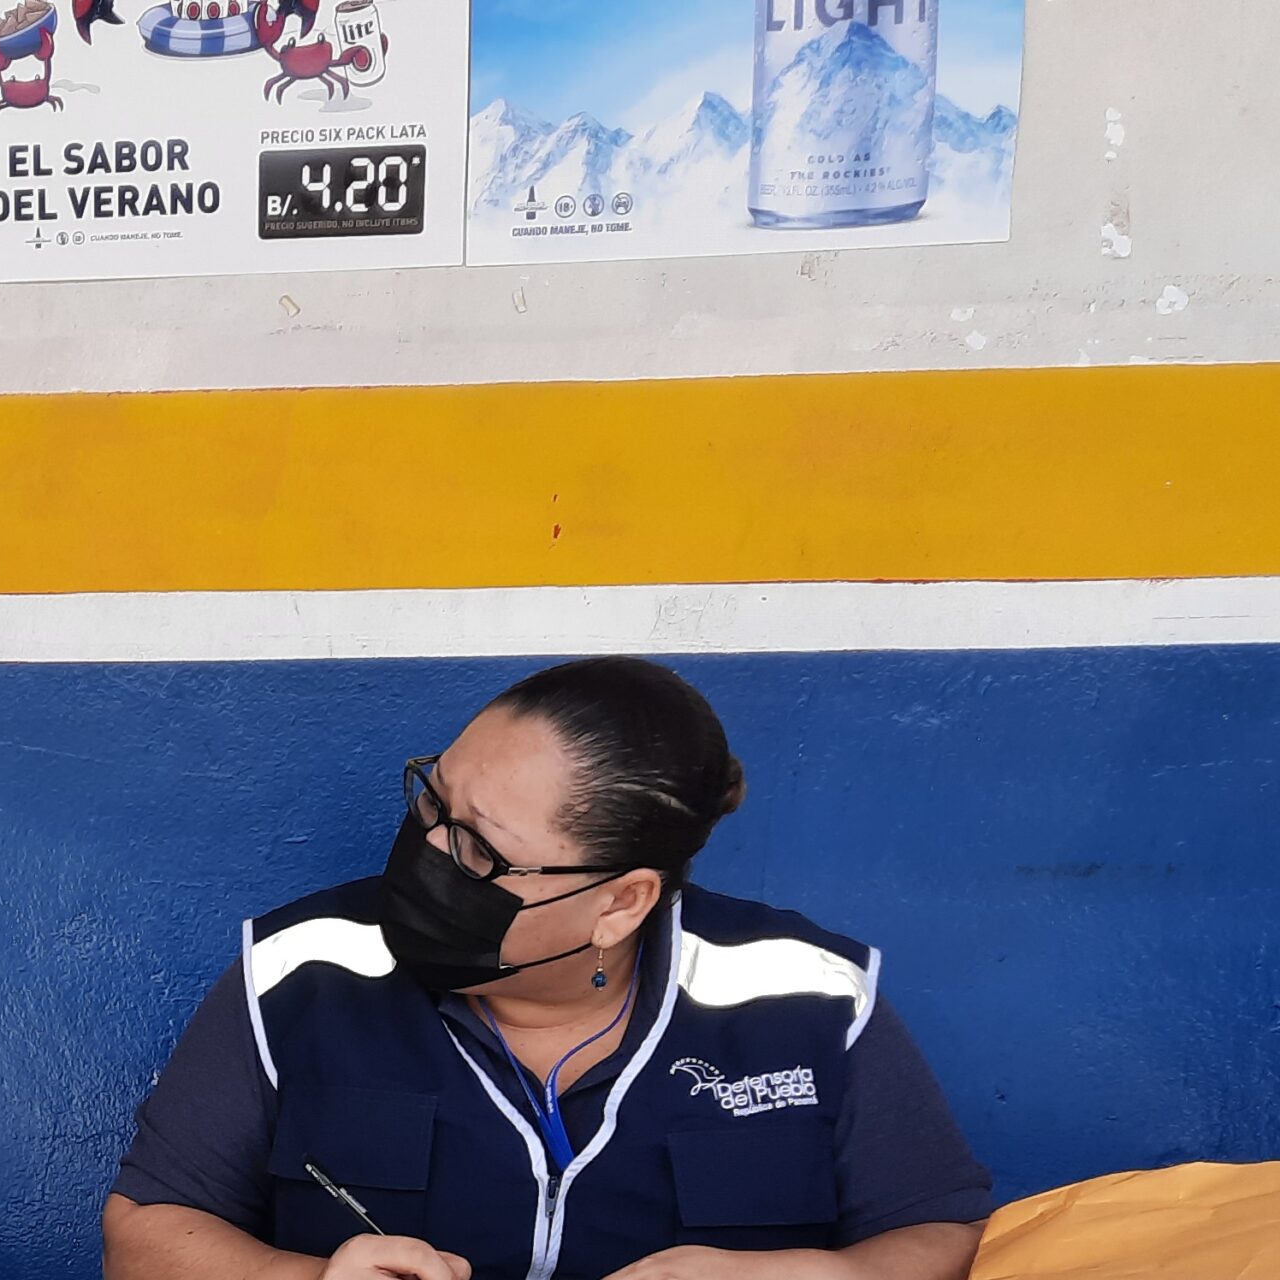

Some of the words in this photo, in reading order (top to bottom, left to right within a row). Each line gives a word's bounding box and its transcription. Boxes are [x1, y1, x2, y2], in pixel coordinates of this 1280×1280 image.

[260, 130, 315, 144] PRECIO
[319, 128, 342, 143] SIX
[347, 126, 386, 141] PACK
[390, 124, 427, 139] LATA
[7, 144, 54, 178] EL
[63, 138, 191, 176] SABOR
[807, 153, 845, 165] COLD
[853, 151, 871, 162] AS
[789, 170, 815, 180] THE
[68, 181, 221, 219] VERANO
[267, 194, 298, 216] B/.
[265, 221, 294, 231] PRECIO
[342, 219, 354, 228] NO
[356, 218, 390, 228] INCLUYE
[512, 226, 548, 237] CUANDO
[590, 224, 603, 233] NO
[756, 1083, 817, 1103] Pueblo
[775, 1099, 787, 1109] de
